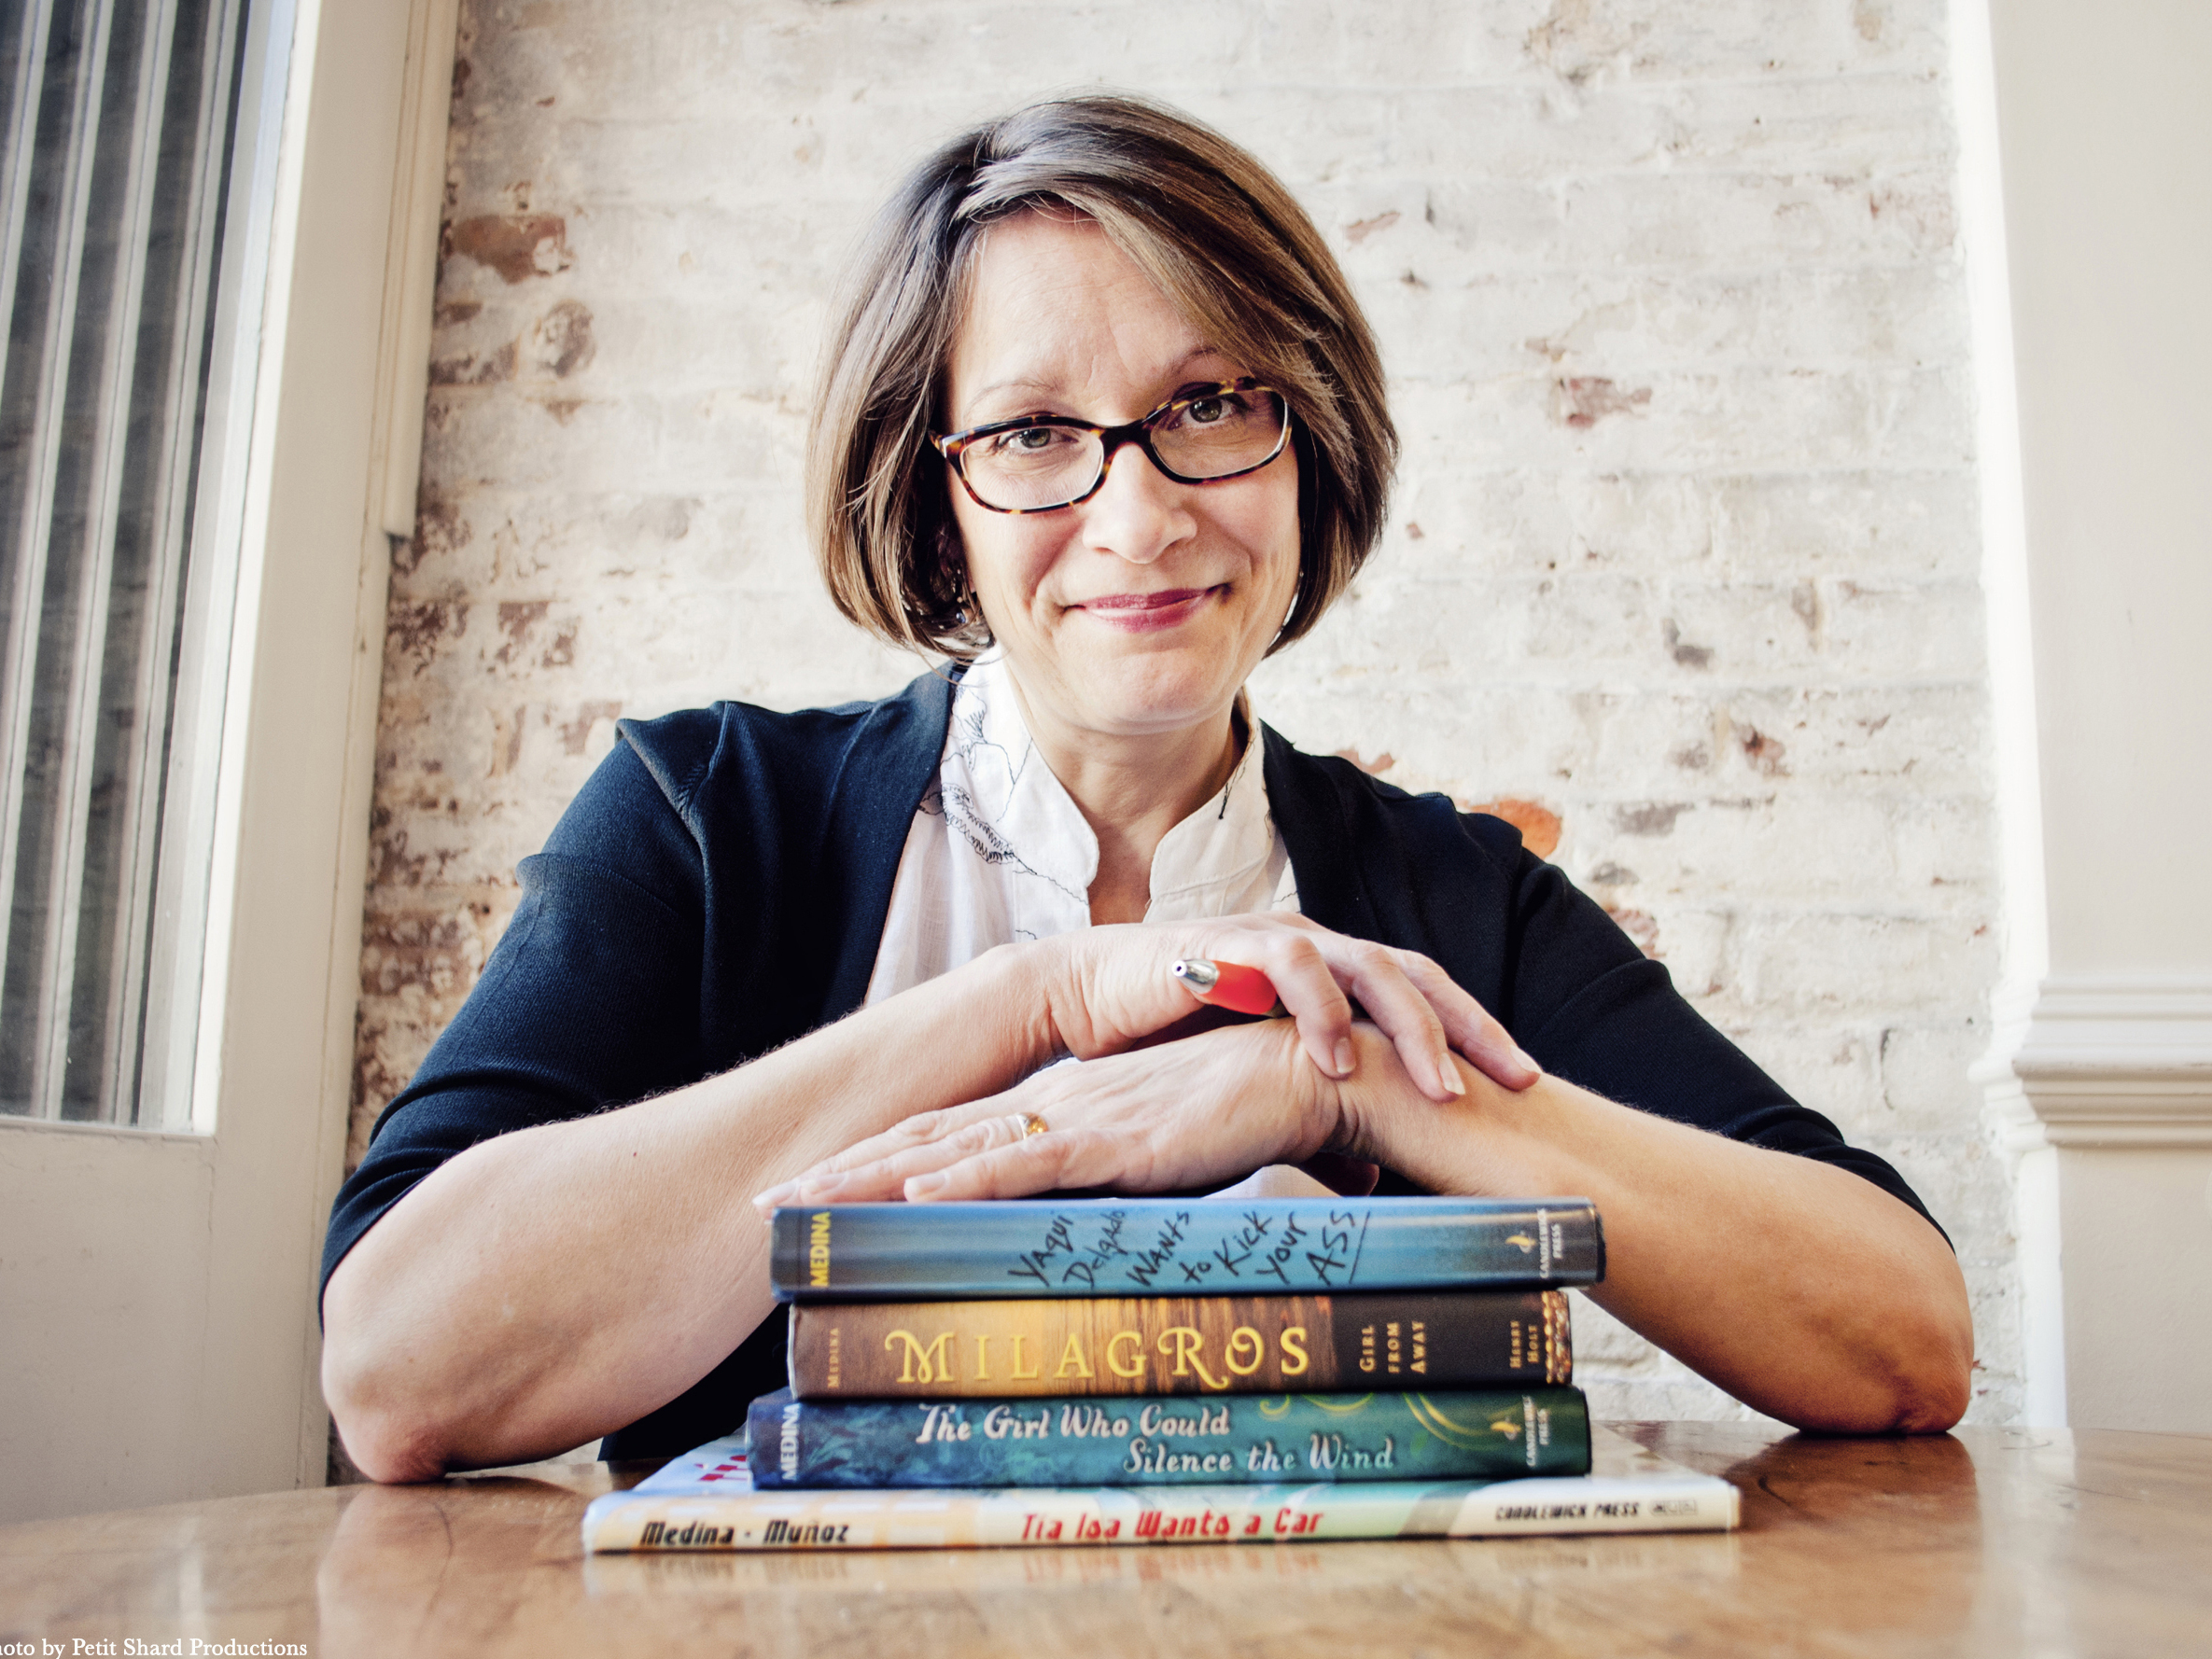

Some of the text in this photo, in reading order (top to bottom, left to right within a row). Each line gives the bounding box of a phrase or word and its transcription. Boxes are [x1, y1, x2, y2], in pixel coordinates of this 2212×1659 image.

[809, 1211, 833, 1288] MEDINA
[1536, 1207, 1550, 1278] CANDLEWICK
[1551, 1223, 1562, 1259] PRESS
[826, 1327, 840, 1389] MEDINA
[884, 1325, 1309, 1389] MILAGROS
[1359, 1325, 1377, 1373] GIRL
[1387, 1321, 1401, 1373] FROM
[1409, 1320, 1427, 1374] AWAY
[780, 1403, 802, 1482] MEDINA
[915, 1403, 1230, 1443] The Girl Who Could
[1123, 1433, 1394, 1472] Silence the Wind
[638, 1520, 735, 1546] Medina
[1075, 1512, 1121, 1540] Isa
[1134, 1509, 1230, 1538] Wants
[1243, 1513, 1261, 1536] a
[1274, 1507, 1323, 1535] Car
[1594, 1501, 1640, 1519] PRESS
